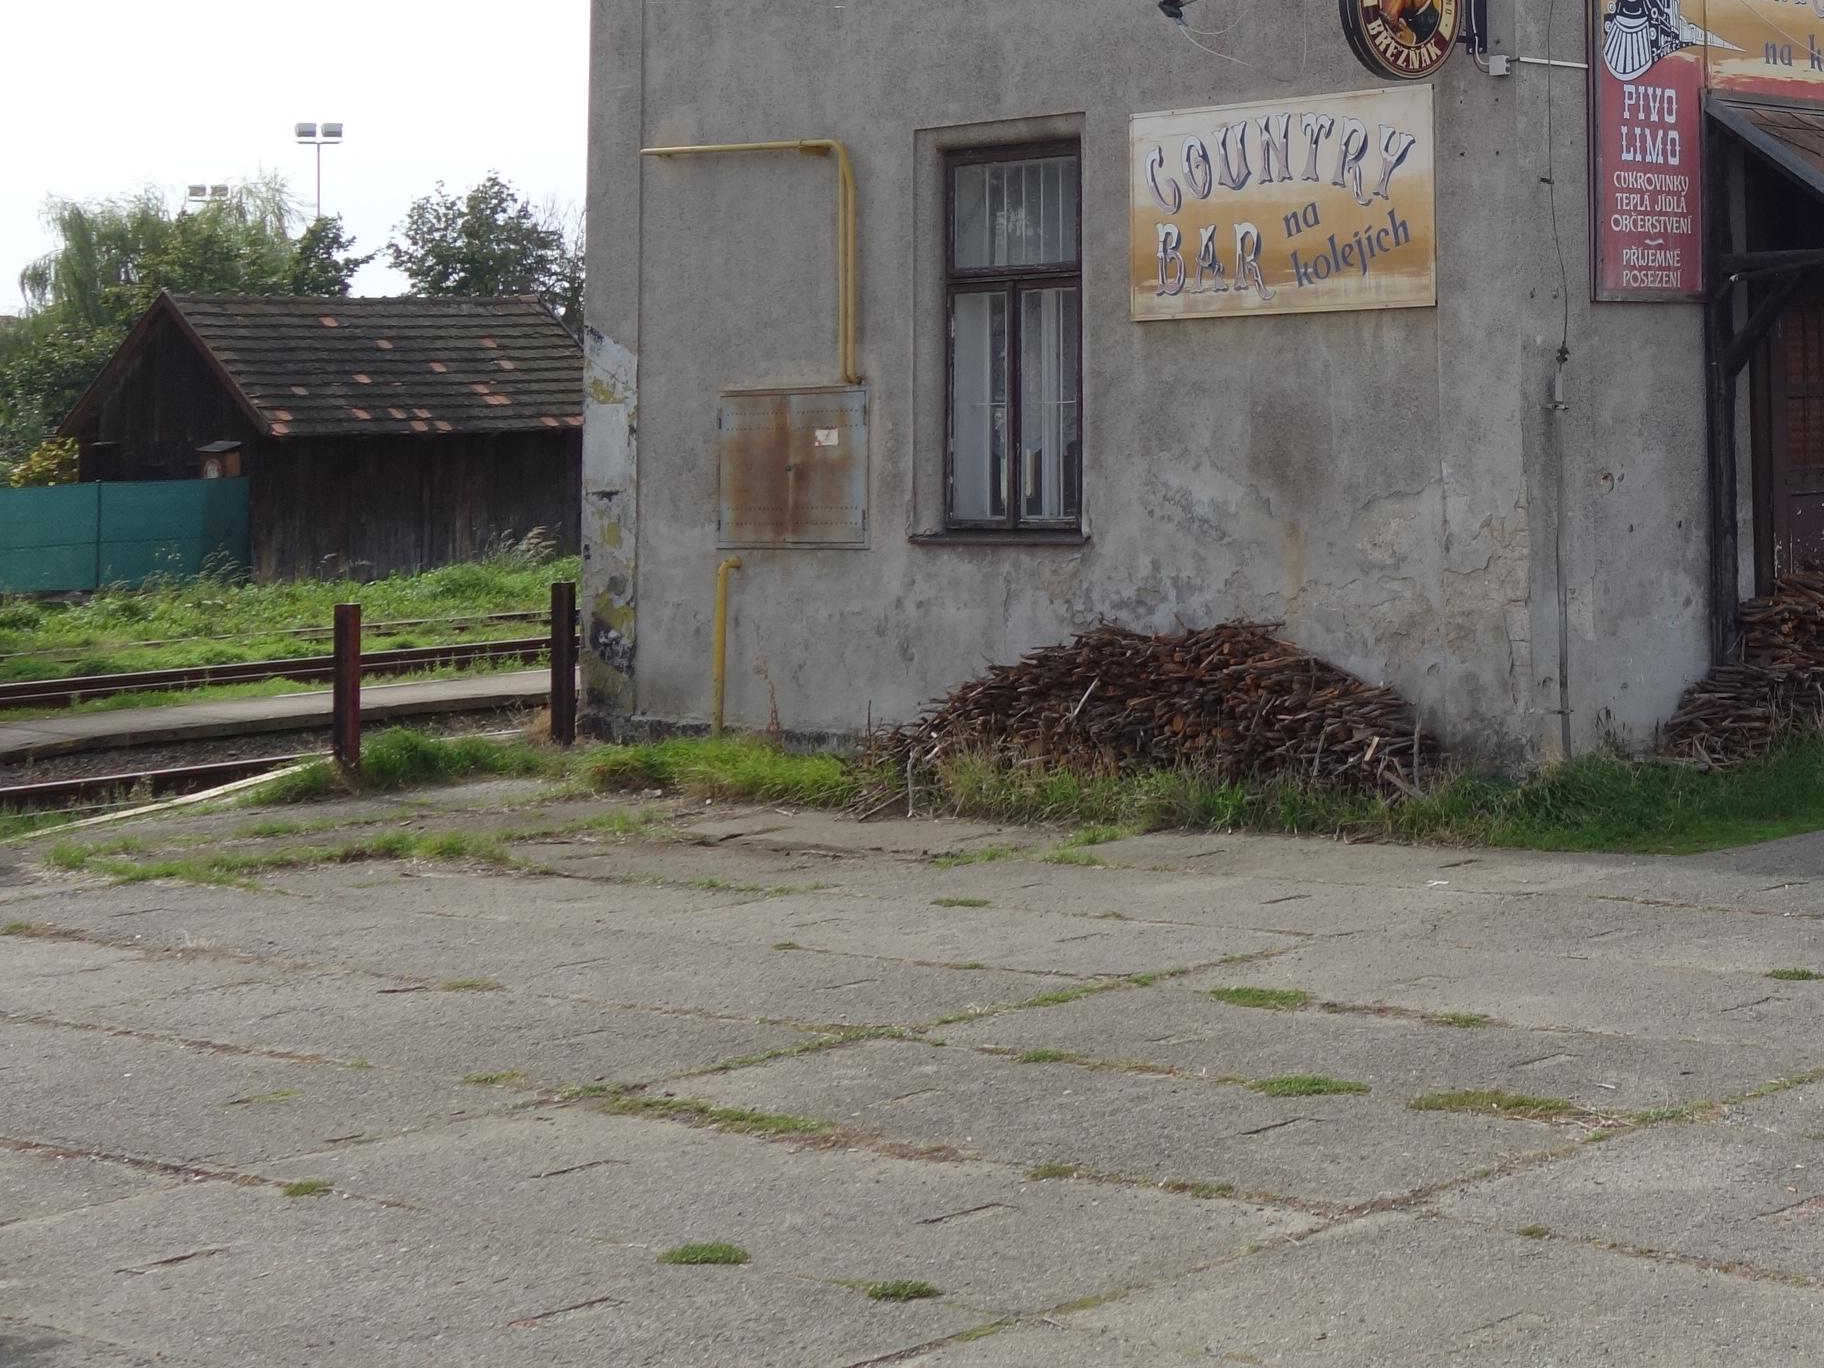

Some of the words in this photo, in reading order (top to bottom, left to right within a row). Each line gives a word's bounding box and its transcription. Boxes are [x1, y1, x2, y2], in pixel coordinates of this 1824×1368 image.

[1764, 40, 1794, 67] na
[1623, 84, 1679, 124] PIVO
[1620, 125, 1681, 166] LIMO
[1144, 112, 1416, 215] COUNTRY
[1613, 170, 1690, 196] CUKROVINKY
[1615, 192, 1650, 211] TEPLÁ
[1654, 193, 1687, 213] JÍDLA
[1282, 201, 1321, 239] na
[1610, 212, 1693, 234] OBČERSTVENÍ
[1156, 222, 1276, 301] BAR
[1290, 207, 1412, 288] kolejích
[1622, 245, 1681, 268] PŘÍJEMNÉ
[1622, 268, 1682, 288] POSEZENÍ
